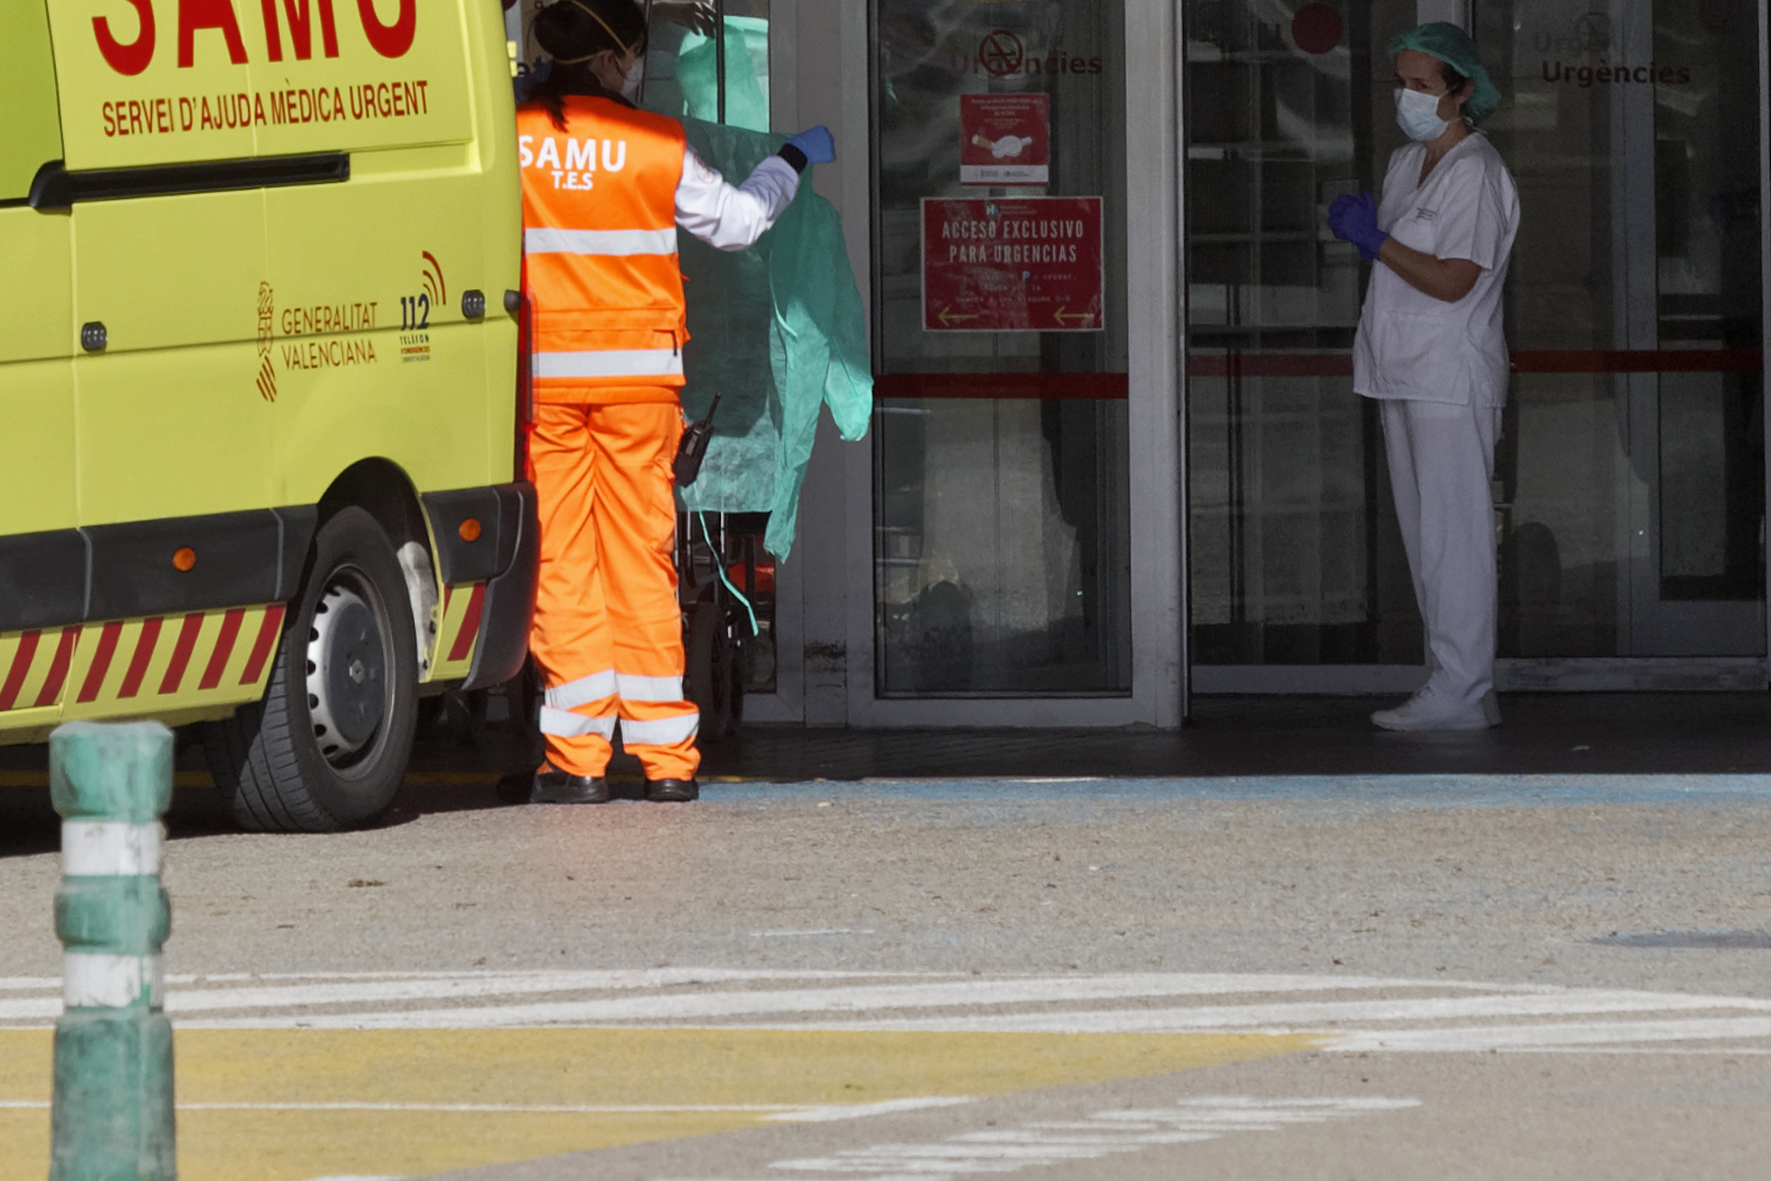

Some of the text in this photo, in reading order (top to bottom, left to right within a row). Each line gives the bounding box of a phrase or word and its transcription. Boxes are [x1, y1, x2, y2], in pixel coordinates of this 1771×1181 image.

[1541, 59, 1691, 88] Urgències
[102, 98, 175, 137] SERVEI
[270, 77, 347, 126] MÈDICA
[349, 80, 428, 119] URGENT
[518, 135, 626, 172] SAMU
[942, 219, 1084, 238] ACCESO EXCLUSIVO
[949, 244, 1077, 263] PARA URGENCIAS
[281, 302, 378, 335] GENERALITAT
[400, 293, 430, 331] 112
[281, 338, 378, 370] VALENCIANA
